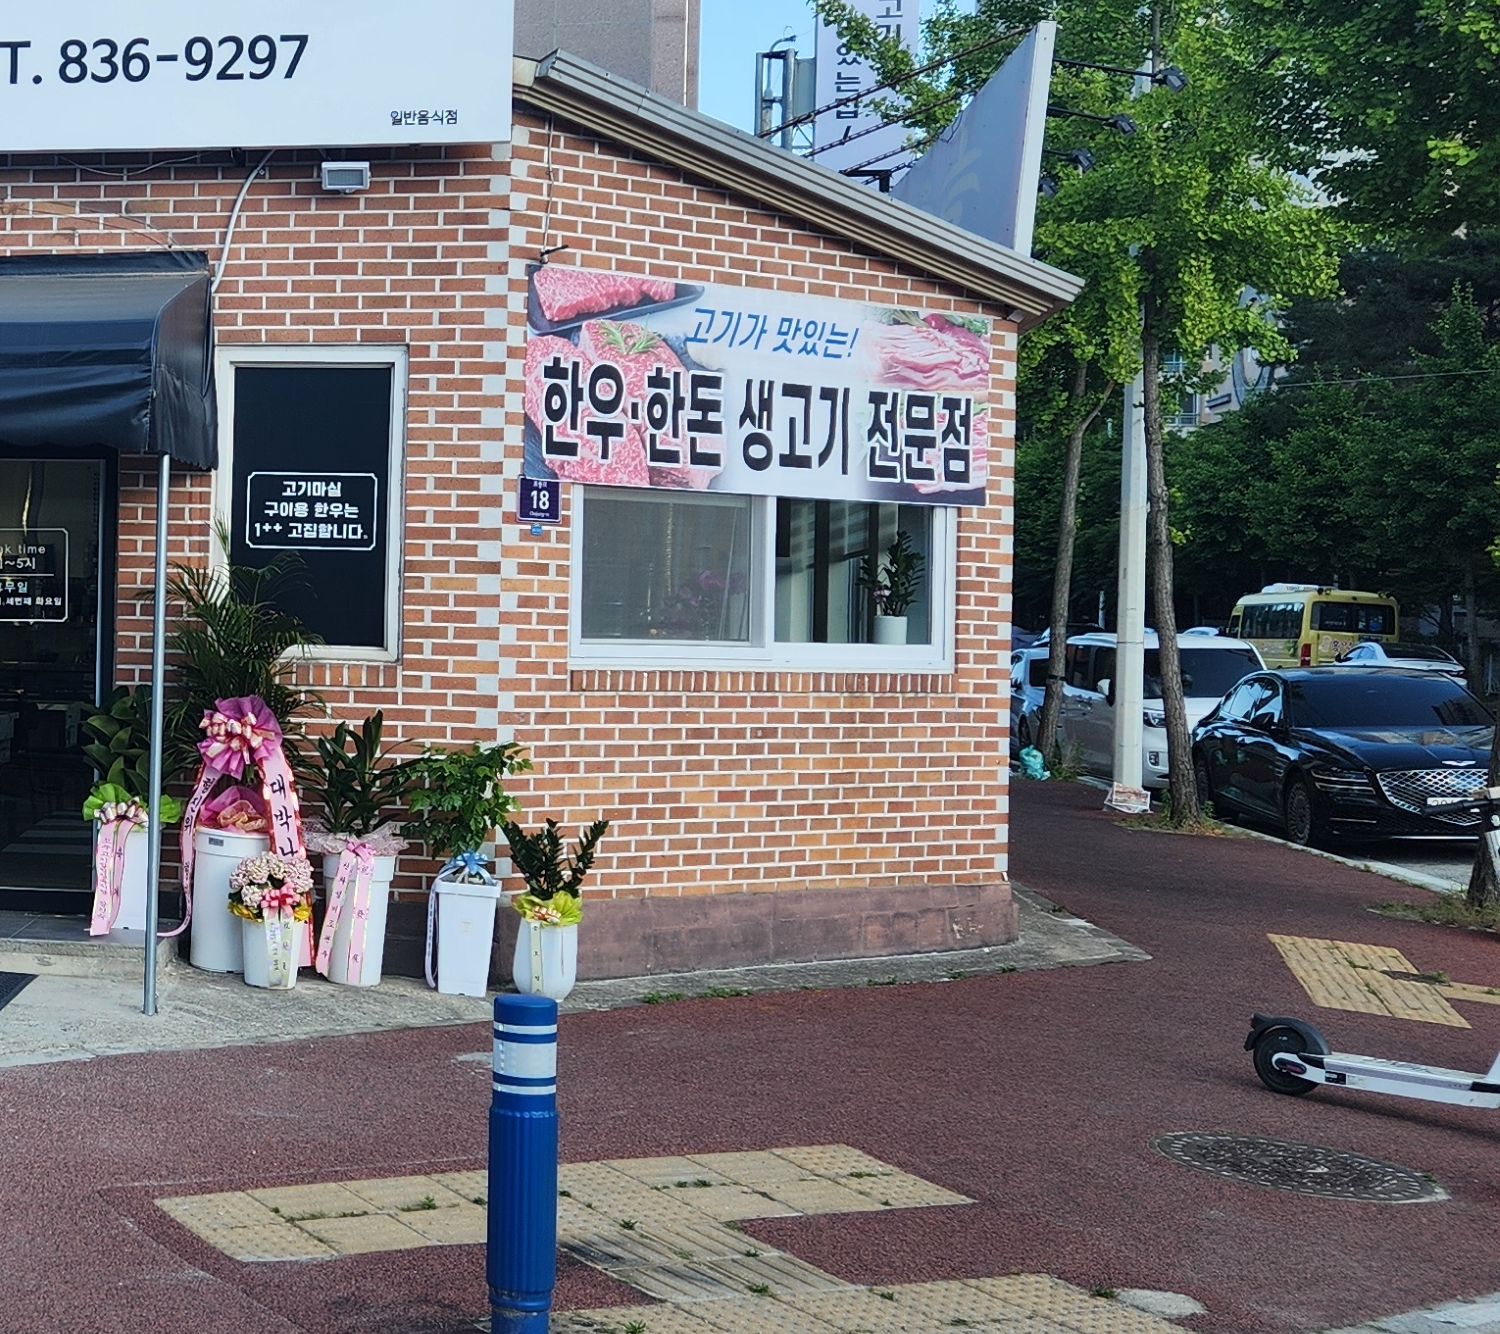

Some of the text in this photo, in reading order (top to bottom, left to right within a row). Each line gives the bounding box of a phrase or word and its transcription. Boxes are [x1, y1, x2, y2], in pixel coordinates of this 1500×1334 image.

[57, 33, 310, 84] 836-9297
[390, 109, 458, 126] 일반음식점
[685, 307, 860, 359] 고기가 맛있는!
[739, 378, 850, 476] 생고기
[867, 390, 973, 485] 전문점
[281, 481, 342, 497] 고기마실
[530, 490, 550, 510] 18
[264, 501, 360, 518] 구이용 한우는
[254, 522, 368, 539] 1++ 고집합니다.
[18, 544, 46, 554] time
[269, 773, 299, 858] 대박나
